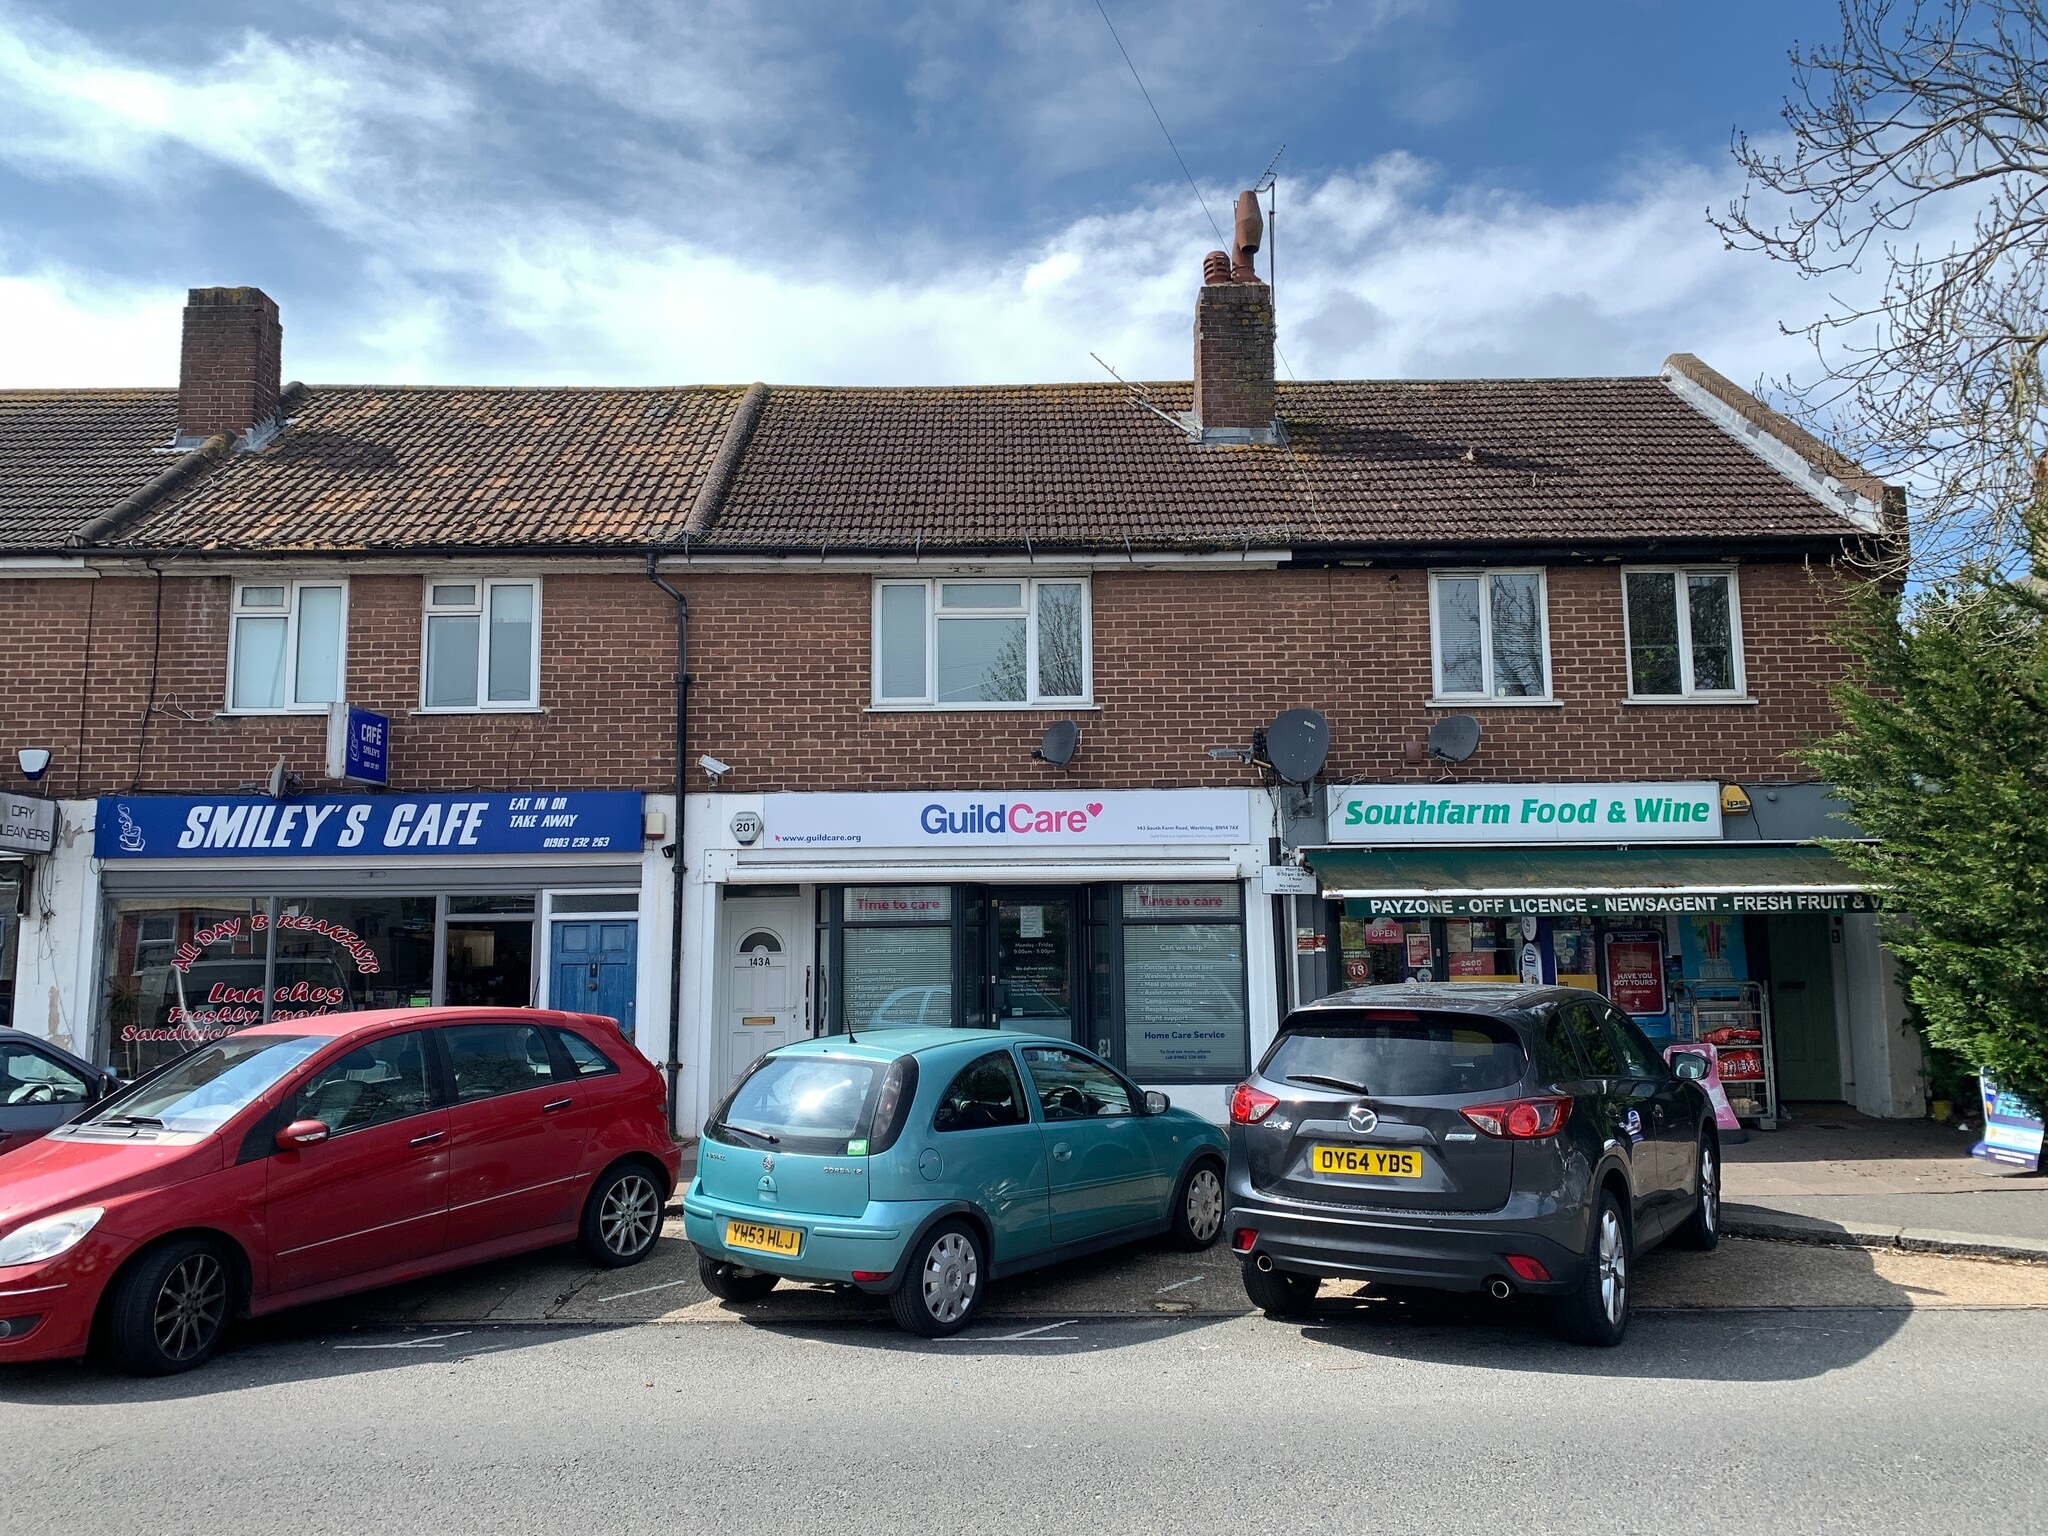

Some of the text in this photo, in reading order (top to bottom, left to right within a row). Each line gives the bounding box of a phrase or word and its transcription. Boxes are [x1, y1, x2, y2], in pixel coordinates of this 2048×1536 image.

[361, 723, 382, 746] CAFÉ
[509, 797, 567, 811] EAT IN OR
[1726, 799, 1748, 808] ips
[11, 804, 36, 819] DRY
[1345, 798, 1710, 825] Southfarm Food & Wine
[177, 803, 490, 849] SMILEY'S CAFE
[509, 814, 578, 828] TAKE AWAY
[920, 803, 1088, 835] GuildCare
[0, 823, 50, 842] LEANERS
[736, 822, 756, 832] 201
[543, 836, 610, 848] 01903 232 263
[782, 834, 862, 843] www.guildcare.org
[856, 898, 940, 910] Time to care
[1139, 895, 1223, 907] Time to care
[1370, 898, 1454, 914] PAYZONE
[1468, 898, 1504, 913] OFF
[1509, 898, 1588, 913] LICENCE
[1604, 896, 1718, 912] NEWSAGENT
[1733, 895, 1792, 911] FRESH
[1797, 895, 1848, 910] FRUIT
[1853, 895, 1866, 909] &
[1371, 929, 1397, 937] OPEN
[171, 943, 200, 973] ALL
[195, 917, 241, 946] DAY
[749, 957, 770, 966] 143A
[1350, 964, 1364, 976] 18
[1617, 972, 1637, 980] HAVE
[168, 1007, 260, 1025] Freshly
[1171, 1031, 1192, 1039] Care
[1193, 1030, 1226, 1039] Service
[1322, 1151, 1413, 1173] OY64 YDS
[823, 1166, 850, 1175] CORSA
[733, 1223, 795, 1250] YH53 HLJ
